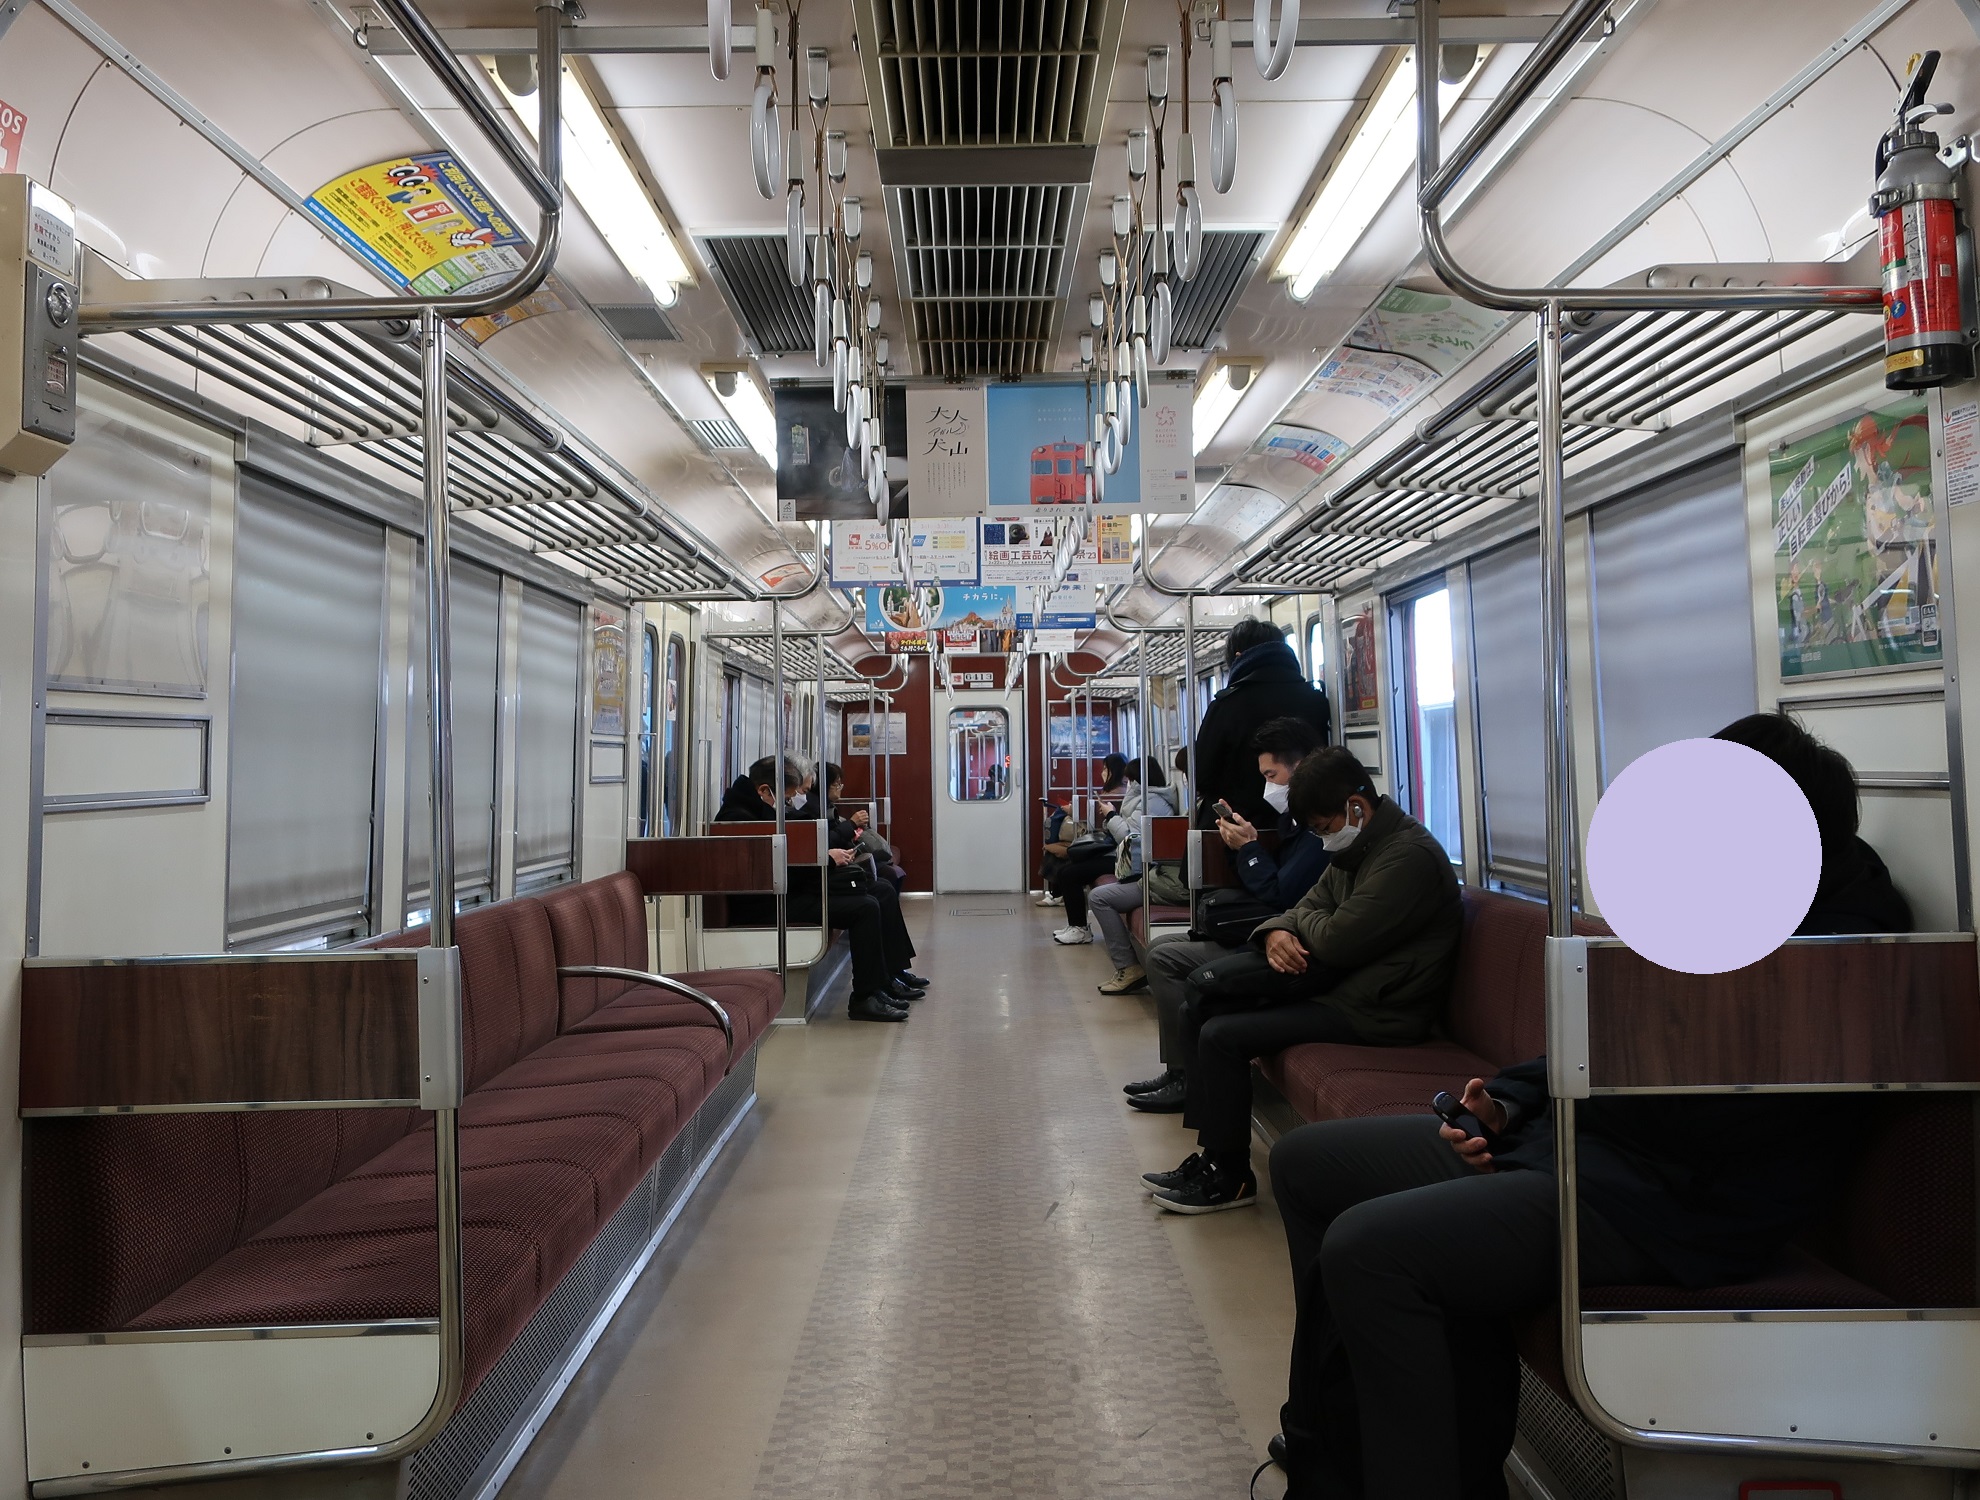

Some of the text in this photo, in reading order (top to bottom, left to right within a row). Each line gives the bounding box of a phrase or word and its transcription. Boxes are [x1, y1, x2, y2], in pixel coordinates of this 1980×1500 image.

[0, 104, 23, 134] OS
[34, 222, 61, 245] 危険ですから
[925, 406, 969, 425] 大人
[922, 438, 968, 457] 犬山
[1777, 501, 1802, 540] 正しい
[864, 540, 892, 550] 5%OF
[962, 593, 1004, 601] チカラに。
